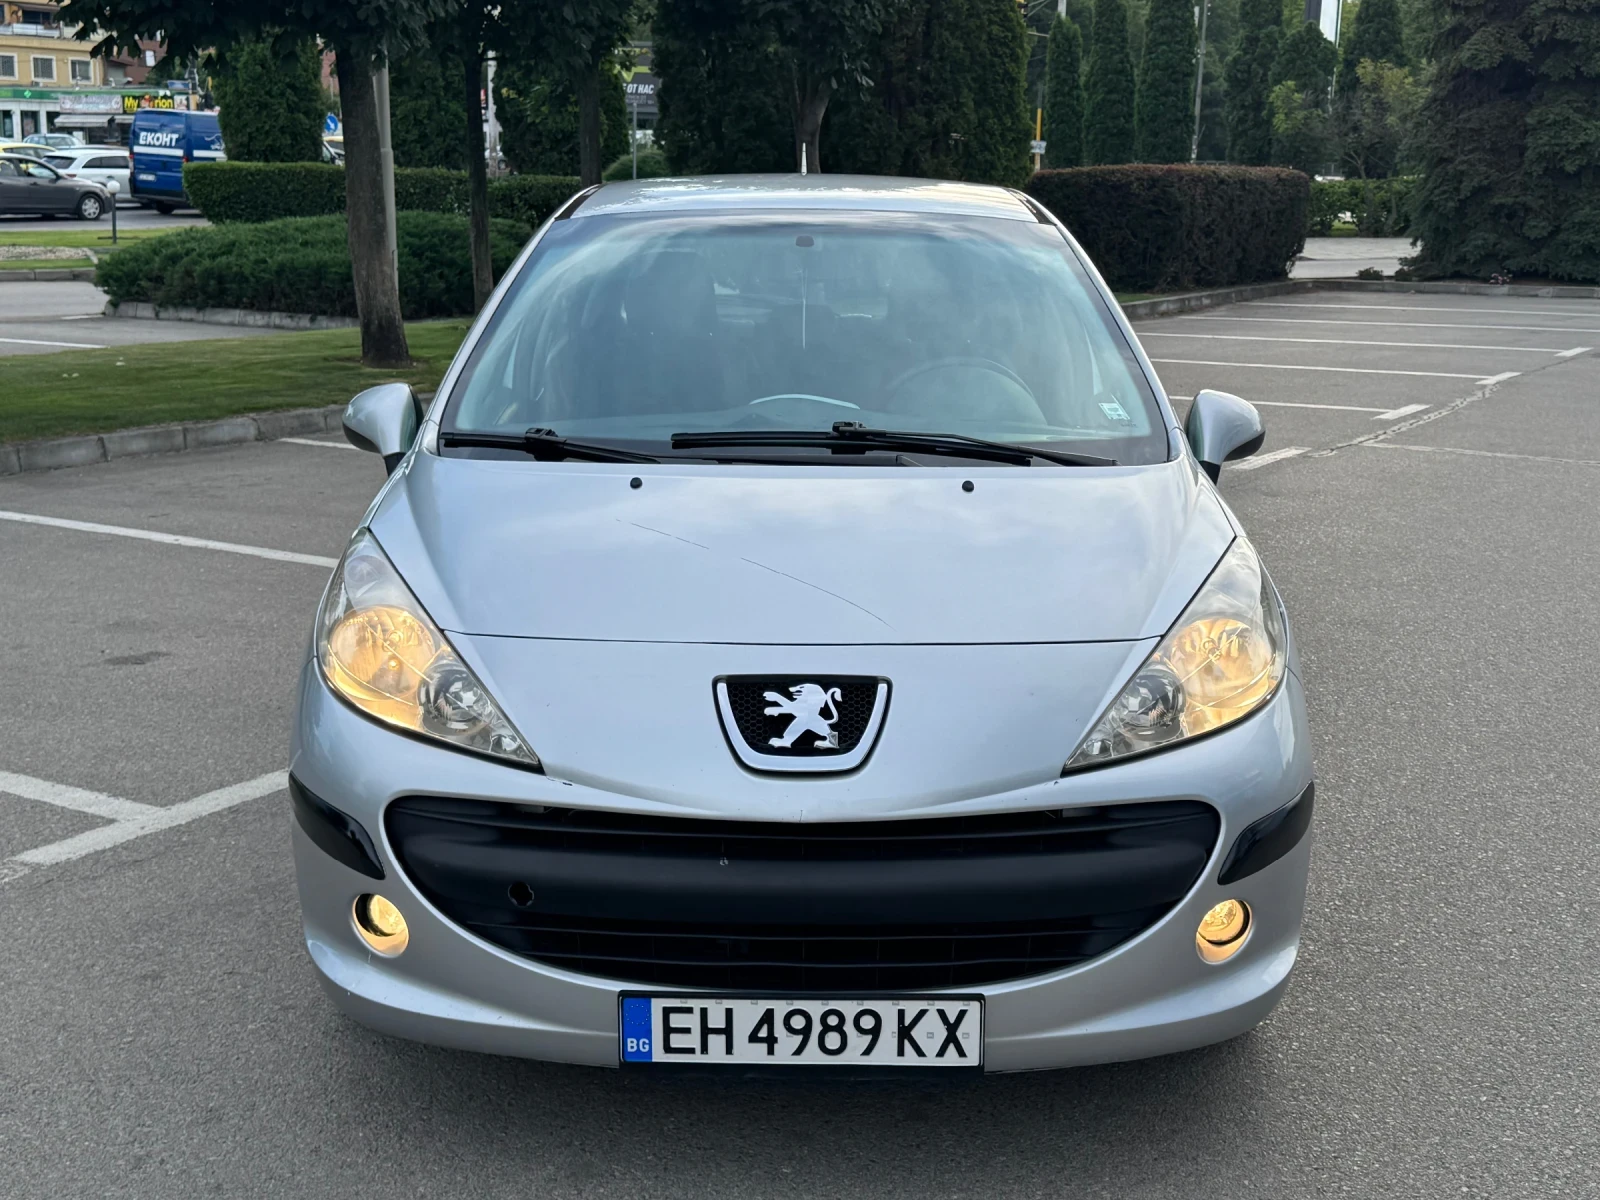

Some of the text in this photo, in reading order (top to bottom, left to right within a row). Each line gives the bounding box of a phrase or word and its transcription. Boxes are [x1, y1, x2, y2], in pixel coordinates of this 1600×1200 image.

[124, 96, 138, 112] My
[139, 131, 179, 147] ЕКОНТ
[662, 1006, 969, 1058] EH 4989 KX
[627, 1038, 650, 1053] BG
